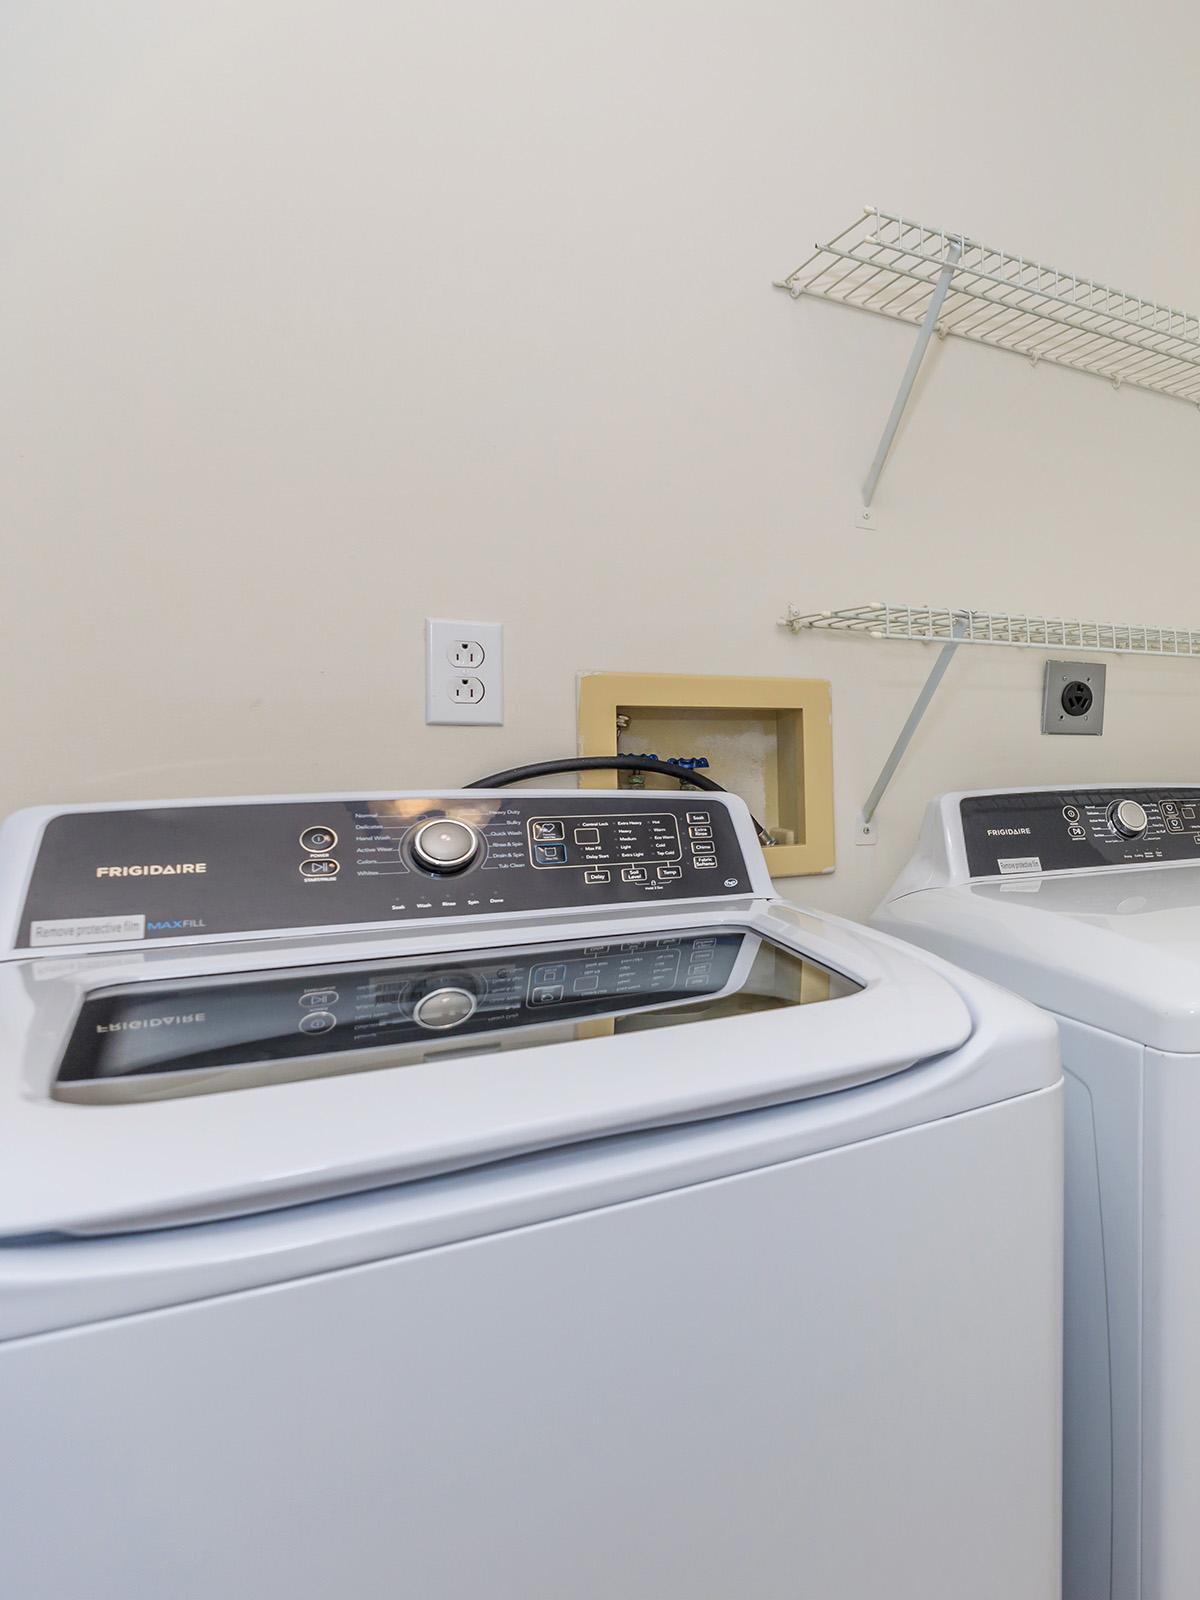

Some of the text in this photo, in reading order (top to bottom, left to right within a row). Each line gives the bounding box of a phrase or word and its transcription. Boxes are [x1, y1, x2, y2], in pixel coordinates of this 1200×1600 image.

[986, 828, 1032, 836] FRIGIDAIRE
[96, 863, 207, 878] FRIGIDAIRE
[36, 920, 140, 938] Remove protective film
[147, 919, 206, 930] MAXFILL
